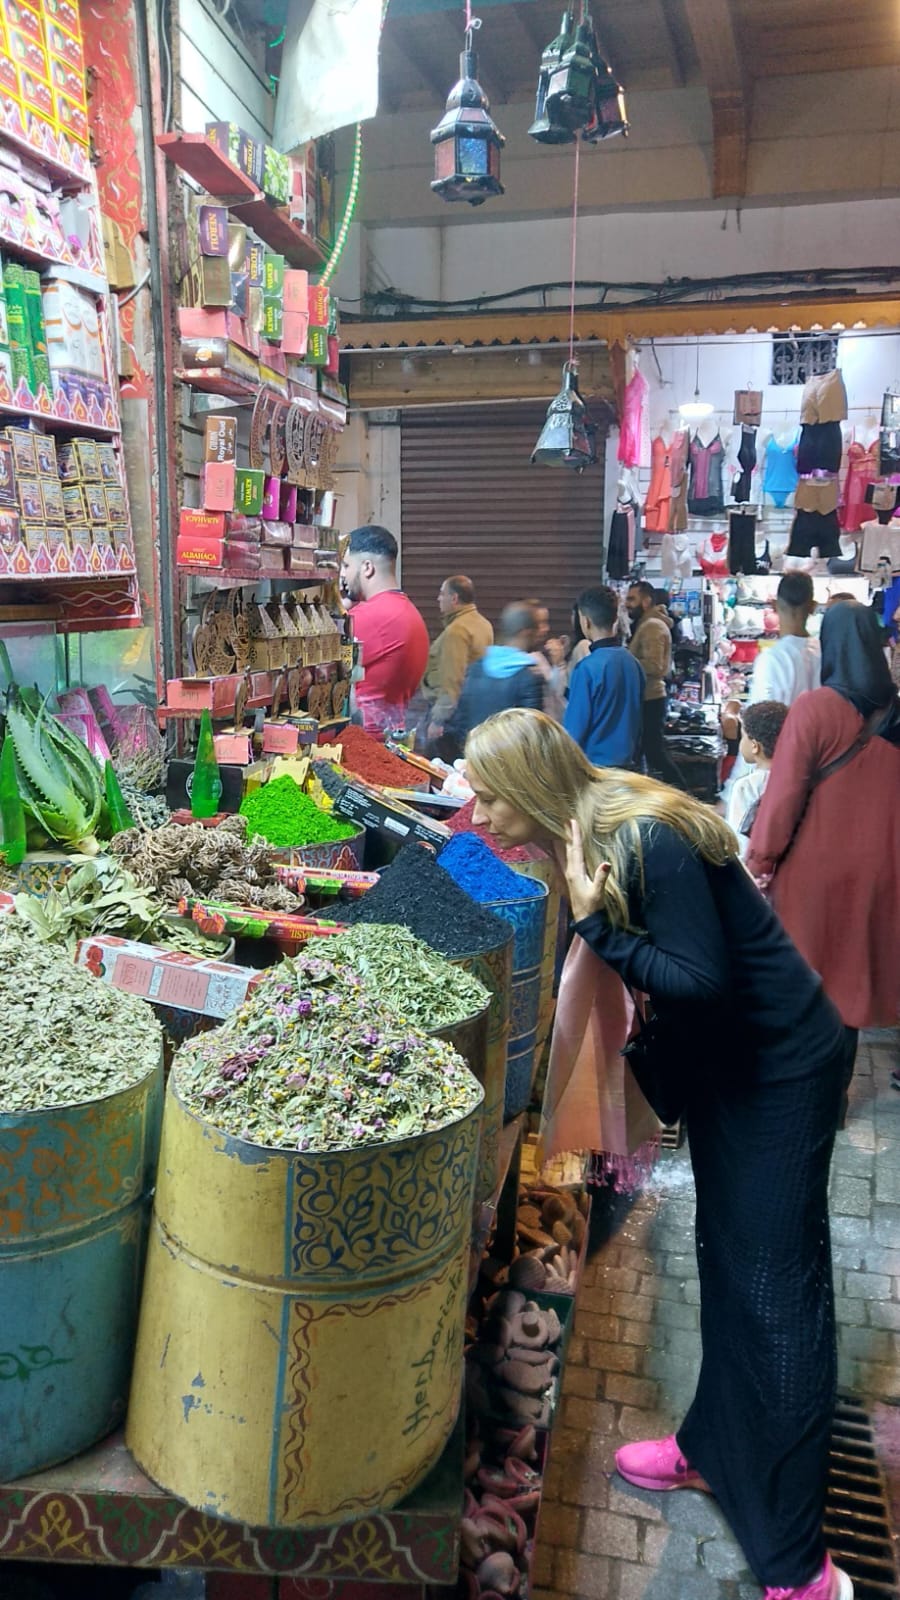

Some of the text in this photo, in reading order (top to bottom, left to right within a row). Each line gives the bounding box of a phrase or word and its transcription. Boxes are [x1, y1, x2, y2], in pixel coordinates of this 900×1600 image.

[208, 212, 220, 251] NEROLI
[250, 247, 258, 281] NEROLI
[266, 305, 274, 333] KEWDA
[217, 420, 227, 461] Royal Oud
[244, 478, 252, 506] KEWDA
[184, 515, 219, 525] ALBAHACA
[181, 551, 217, 561] ALBAHACA
